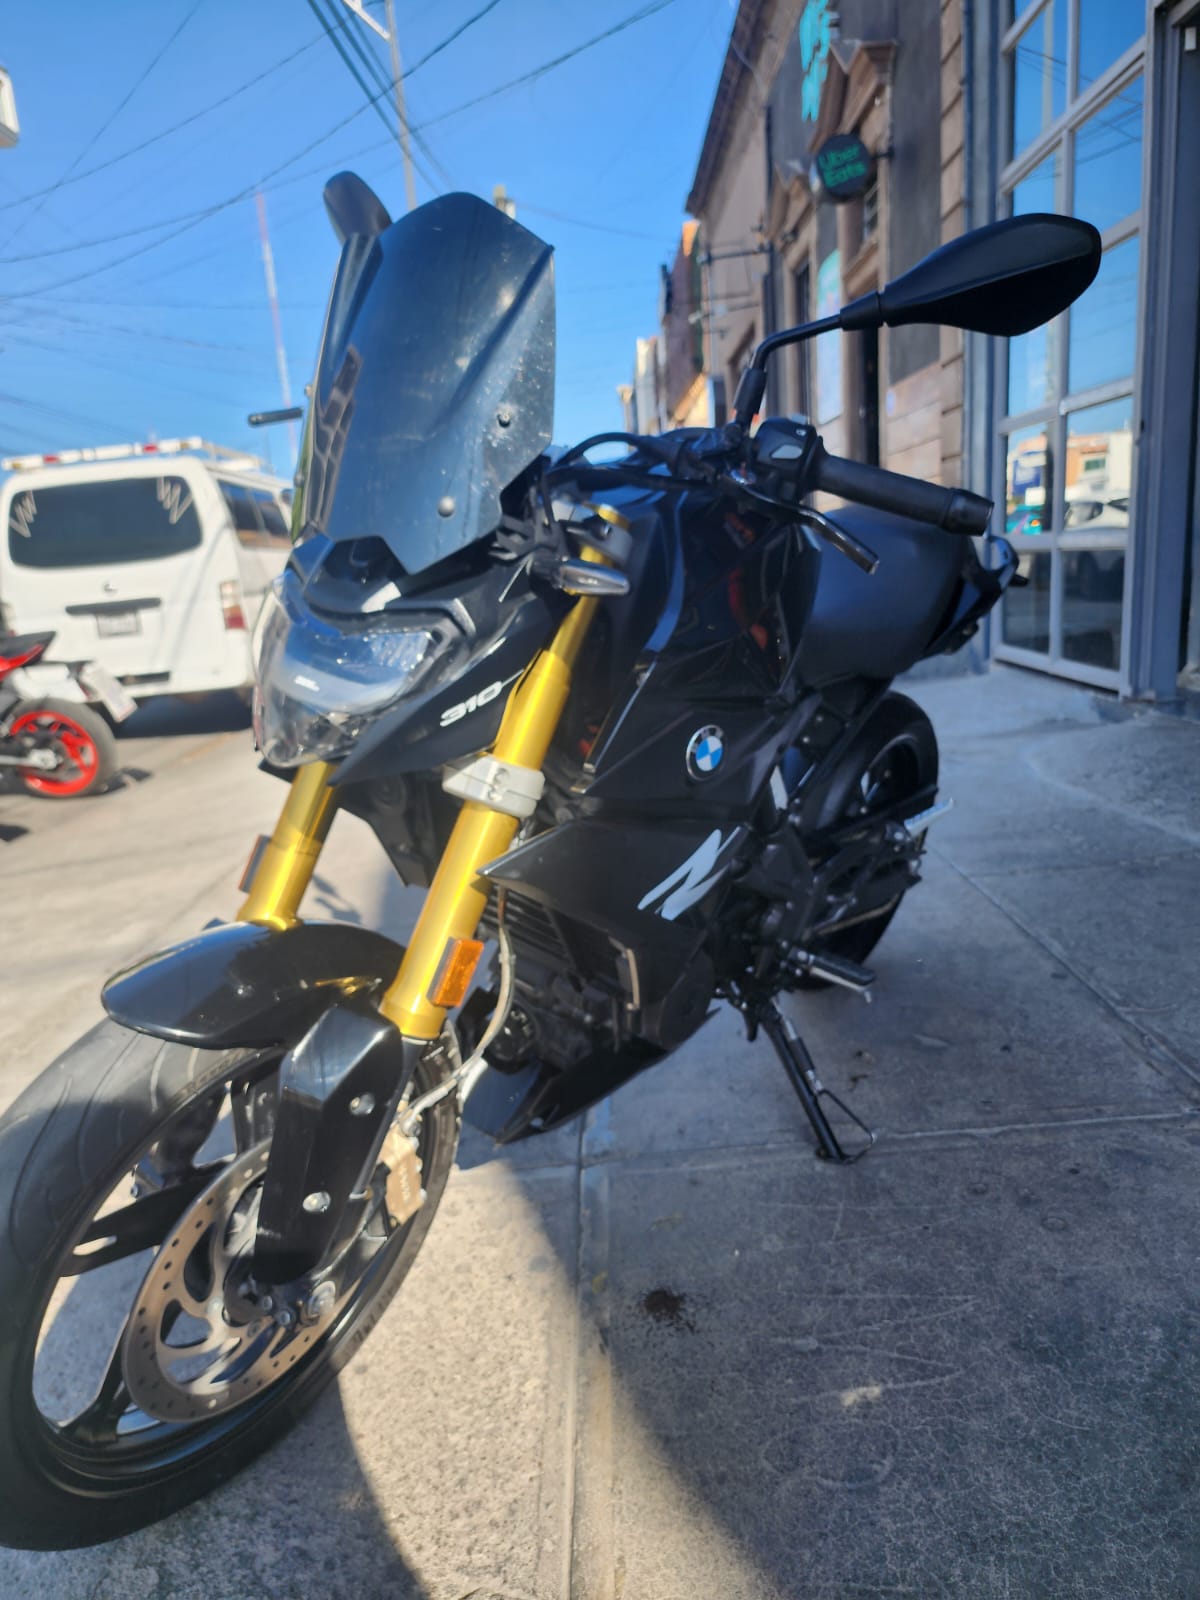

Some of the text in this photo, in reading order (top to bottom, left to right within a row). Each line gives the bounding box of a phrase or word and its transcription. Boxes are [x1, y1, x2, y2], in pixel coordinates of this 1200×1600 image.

[818, 144, 860, 170] Uber
[824, 161, 866, 188] Eats
[440, 681, 503, 727] 310
